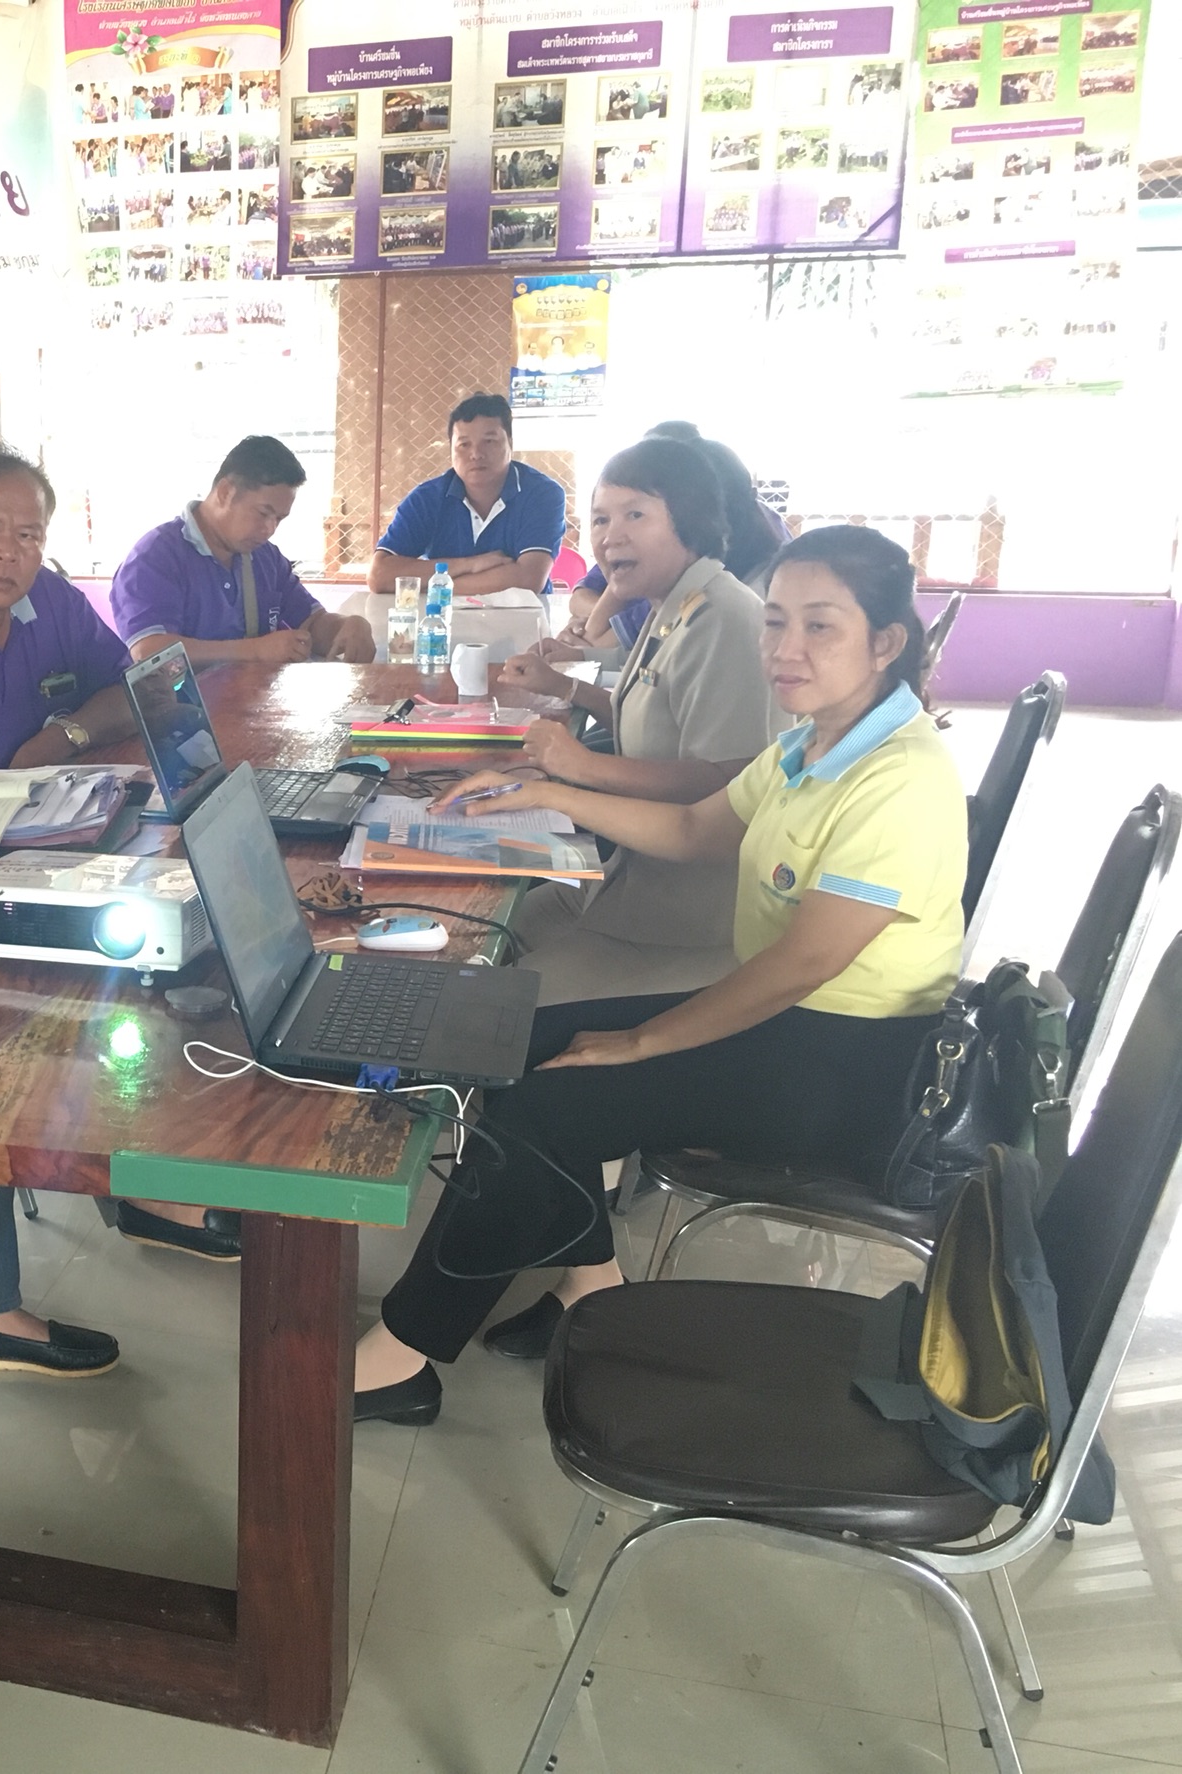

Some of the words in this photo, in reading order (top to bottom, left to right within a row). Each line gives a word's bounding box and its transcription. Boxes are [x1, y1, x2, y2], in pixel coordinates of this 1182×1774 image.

[770, 17, 838, 34] การดำเนินกิจกรรม
[358, 46, 401, 62] บ้านศรีชมชื่น
[326, 63, 433, 86] หมู่บ้านโครงการเศรษฐกิจพอเพียง
